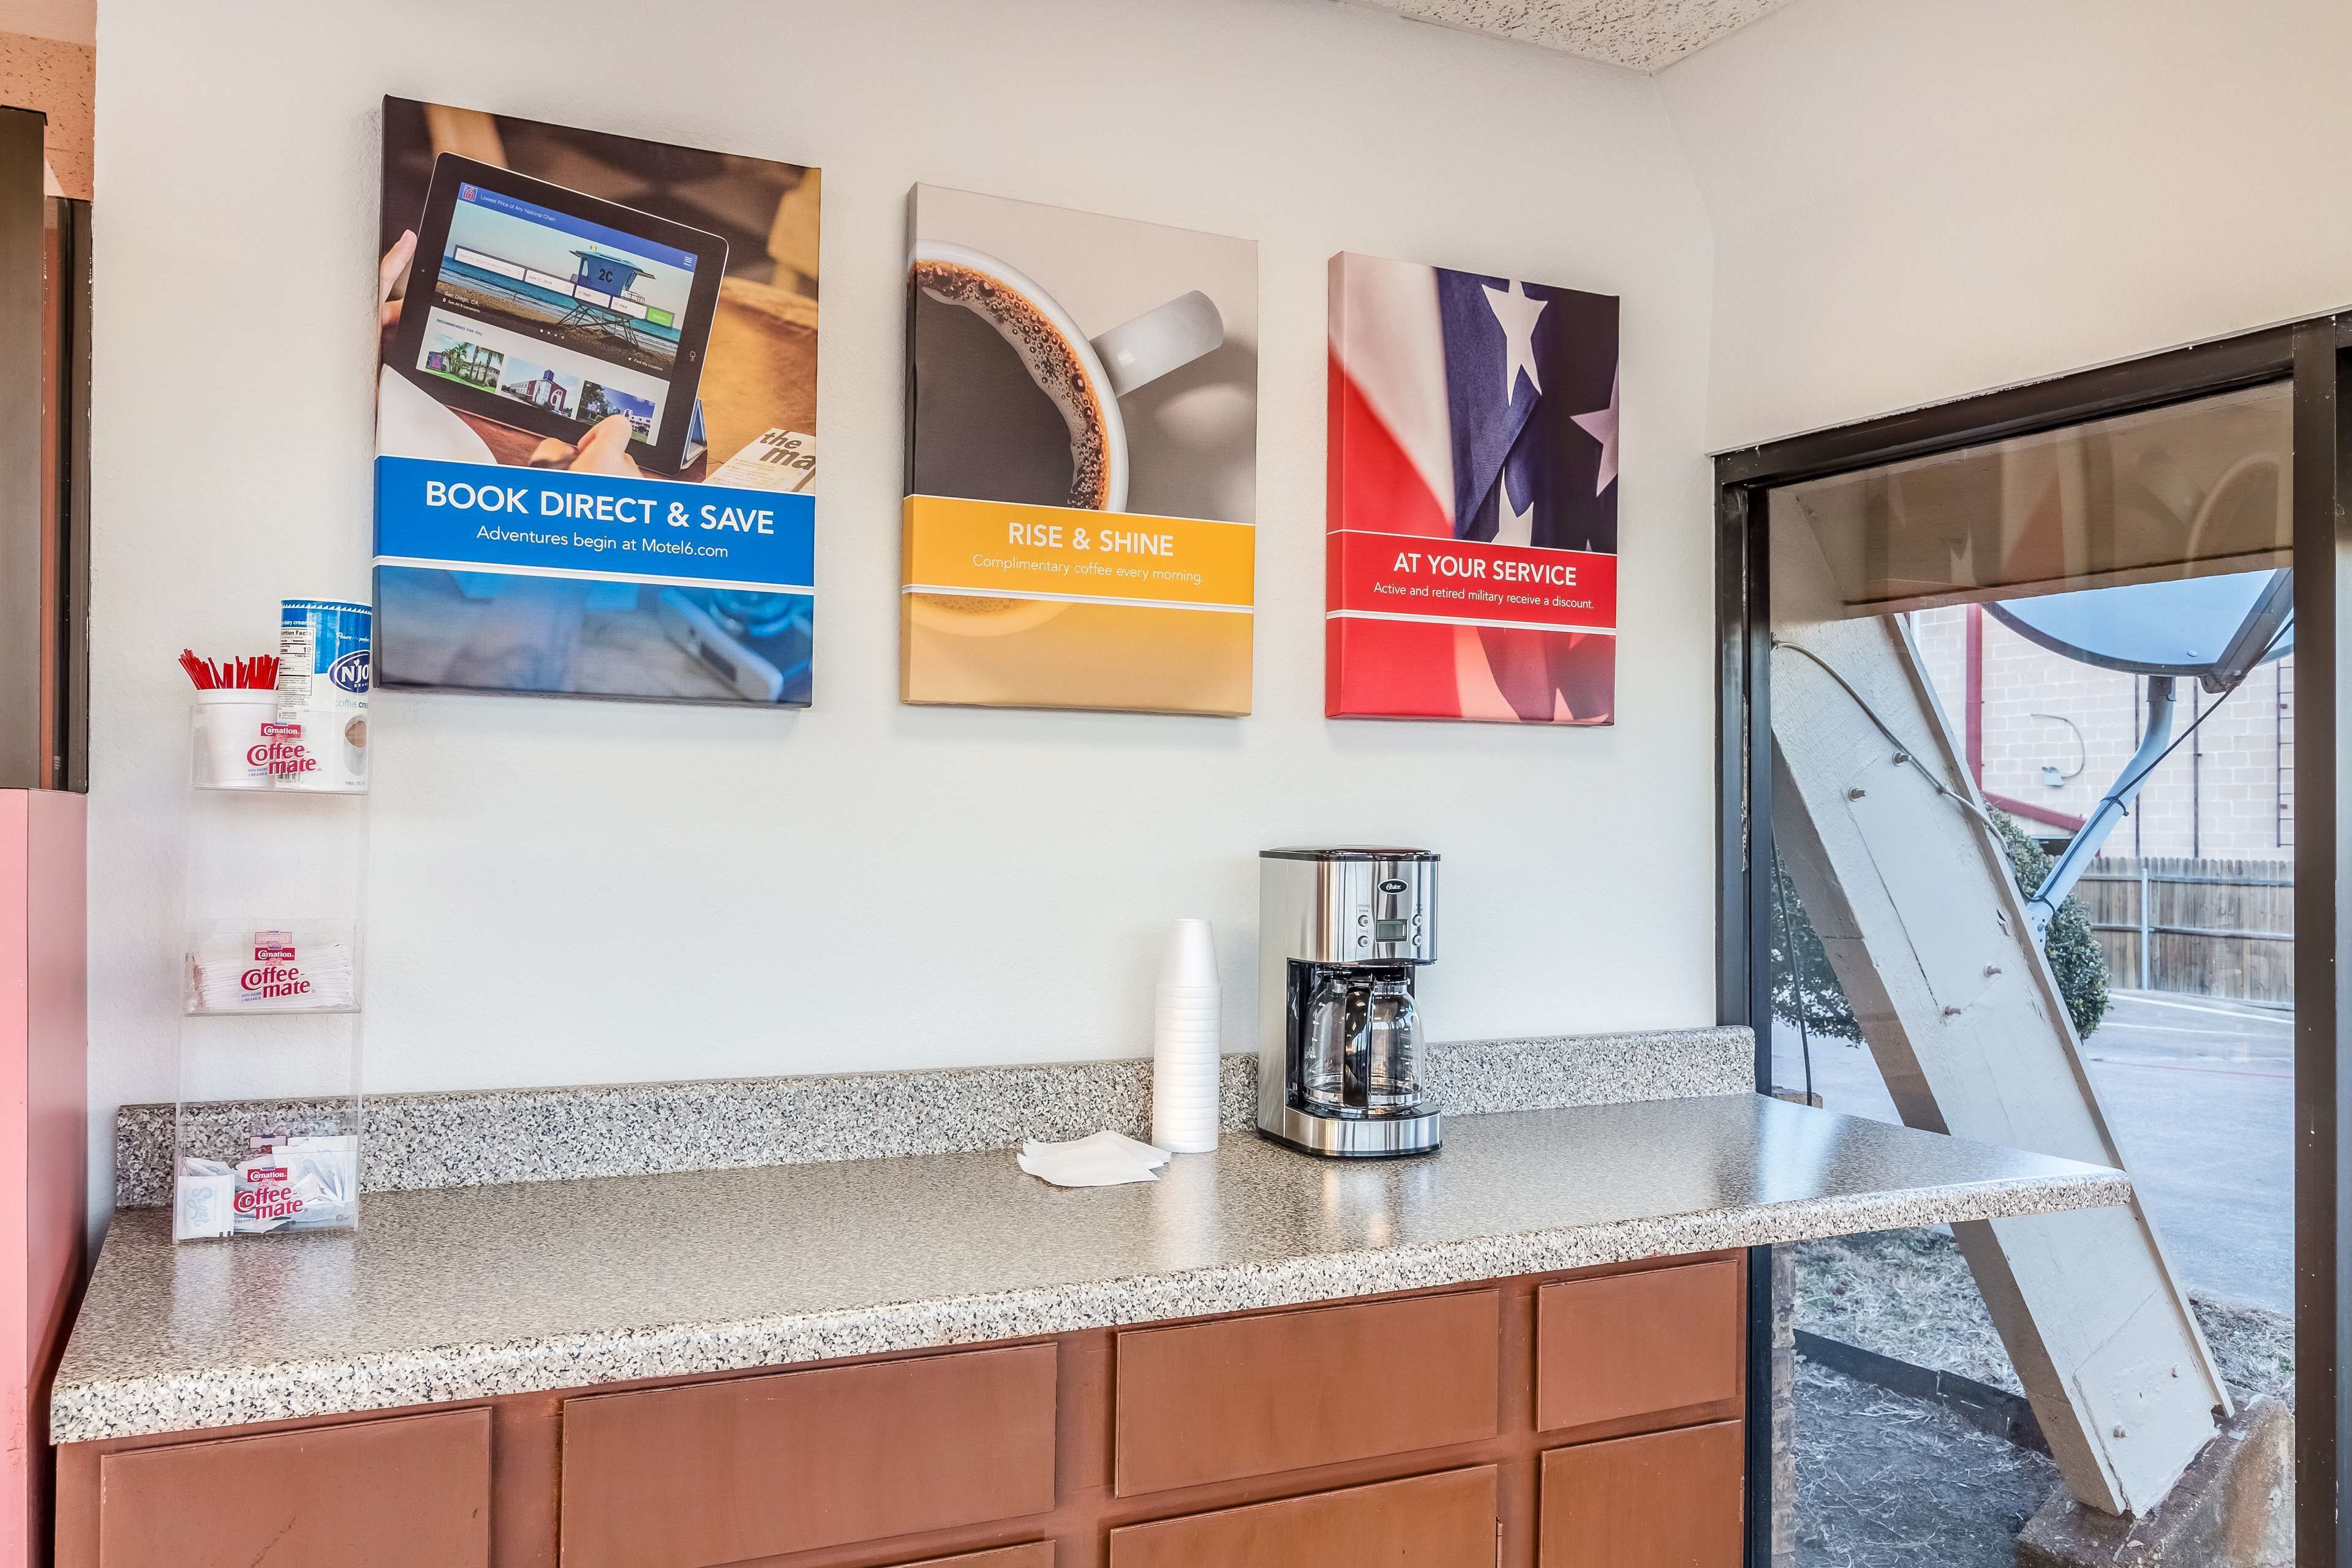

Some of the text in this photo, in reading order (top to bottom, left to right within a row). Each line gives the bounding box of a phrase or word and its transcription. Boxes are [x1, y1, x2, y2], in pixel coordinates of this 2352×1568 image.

[480, 194, 497, 204] Lowest
[497, 199, 509, 208] Price
[524, 208, 543, 218] National
[543, 213, 556, 222] Chain
[598, 268, 613, 284] 2C
[444, 290, 454, 299] San
[436, 318, 466, 331] RECOMMENDED
[760, 431, 802, 450] the
[760, 447, 816, 470] ma
[426, 480, 774, 535] BOOK DIRECT & SAVE
[476, 525, 728, 557] Adventures begin at Motel6.com
[1009, 522, 1174, 557] RISE & SHINE
[972, 554, 1204, 586] Complimentary coffee every morning.
[1393, 552, 1577, 586] AT YOUR SERVICE
[1373, 581, 1406, 595] Active
[1409, 585, 1429, 597] and
[1432, 587, 1465, 600] retired
[1468, 589, 1504, 605] military
[1507, 594, 1541, 605] receive
[1552, 595, 1594, 609] discount.
[263, 726, 298, 736] Carnation
[268, 758, 317, 775] mate
[258, 950, 292, 960] Carnation
[262, 980, 311, 998] mate
[250, 1171, 284, 1181] Carnation
[255, 1199, 303, 1220] mate
